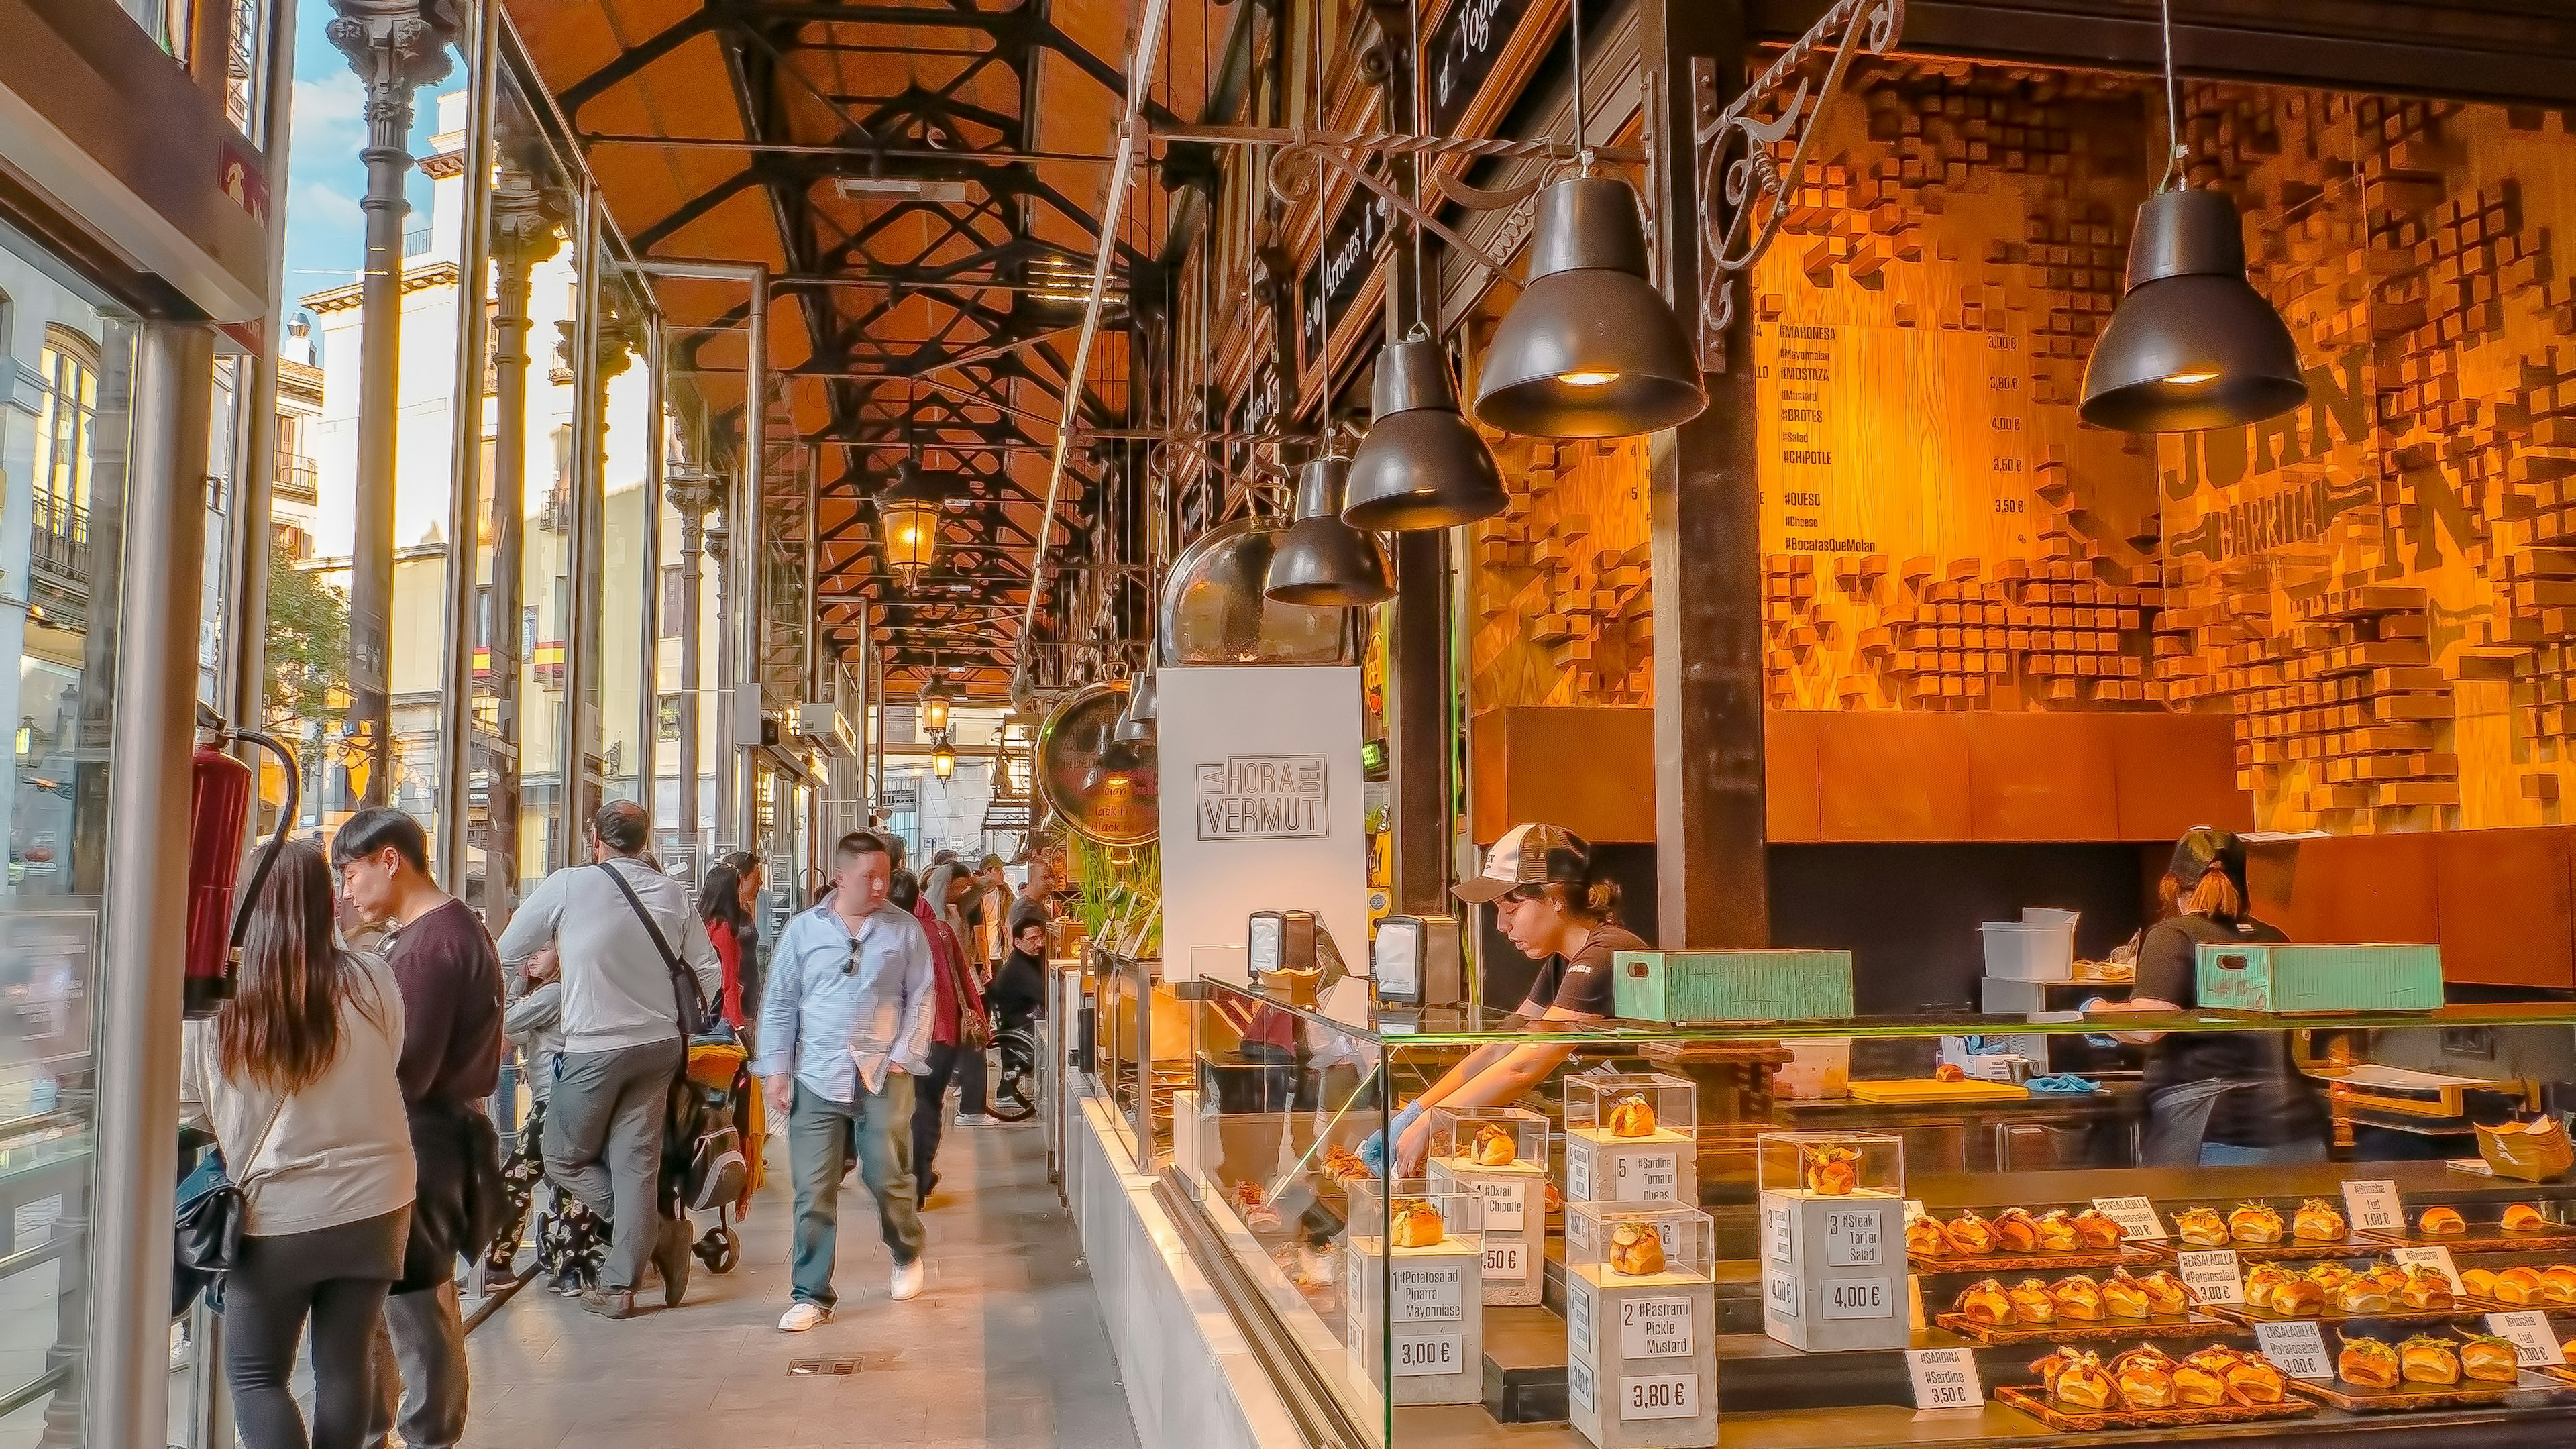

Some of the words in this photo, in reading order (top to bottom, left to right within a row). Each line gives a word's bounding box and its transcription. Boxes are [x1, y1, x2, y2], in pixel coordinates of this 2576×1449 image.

[1780, 325, 1836, 341] #MAHONESA
[1781, 367, 1829, 382] #MOSTAZA
[1781, 390, 1817, 402] #Mustard
[1782, 409, 1823, 423] #BROTES
[1782, 431, 1808, 443] #Salad
[1784, 450, 1831, 465] #CHIPOTLE
[1785, 492, 1821, 506] #QUESO
[1995, 499, 2015, 513] 3,50
[1786, 515, 1818, 527] #Cheese
[1786, 537, 1875, 553] #BocatasQueMolan
[1203, 768, 1225, 794] LA
[1228, 762, 1295, 794] HORA
[1299, 761, 1320, 793] DEL
[1203, 796, 1321, 833] VERMUT
[1619, 1158, 1627, 1177] 5
[1638, 1157, 1671, 1169] #Sardine
[1644, 1173, 1673, 1185] Tomato
[1485, 1185, 1511, 1197] #Oxtail
[2354, 1183, 2385, 1195] #Brioche
[1489, 1200, 1521, 1213] Chipotle
[1830, 1216, 1838, 1234] 3
[1843, 1214, 1874, 1228] #Steak
[2125, 1226, 2143, 1237] ,00
[2145, 1225, 2152, 1235] €
[1849, 1231, 1878, 1244] TarTar
[1483, 1250, 1504, 1270] ,50
[1508, 1250, 1516, 1269] €
[1850, 1248, 1874, 1261] Salad
[2182, 1252, 2234, 1268] #ENSALADILLA
[1400, 1269, 1458, 1284] #Potatosalad
[2186, 1269, 2235, 1283] #Potatosalad
[1406, 1287, 1437, 1301] Piparra
[1835, 1286, 1867, 1309] 4,00
[1872, 1285, 1880, 1307] €
[2200, 1286, 2222, 1301] 3,00
[2223, 1285, 2230, 1299] €
[1625, 1305, 1633, 1326] 2
[1639, 1302, 1688, 1318] #Pastrami
[2506, 1315, 2536, 1327] Brioche
[1646, 1320, 1675, 1336] Pickle
[2265, 1324, 2316, 1338] ENSALADILLA
[1647, 1338, 1687, 1354] Mustard
[2270, 1342, 2320, 1355] Potatosalad
[2539, 1346, 2548, 1360] €
[1401, 1342, 1436, 1366] 3,00
[1440, 1342, 1450, 1362] €
[1919, 1351, 1960, 1365] #SARDINA
[2284, 1358, 2306, 1374] 3,00
[2310, 1358, 2317, 1373] €
[1925, 1370, 1965, 1385] #Sardine
[1633, 1383, 1670, 1409] 3,80
[1674, 1383, 1685, 1405] €
[1931, 1387, 1955, 1405] 3,50
[1959, 1386, 1966, 1402] €
